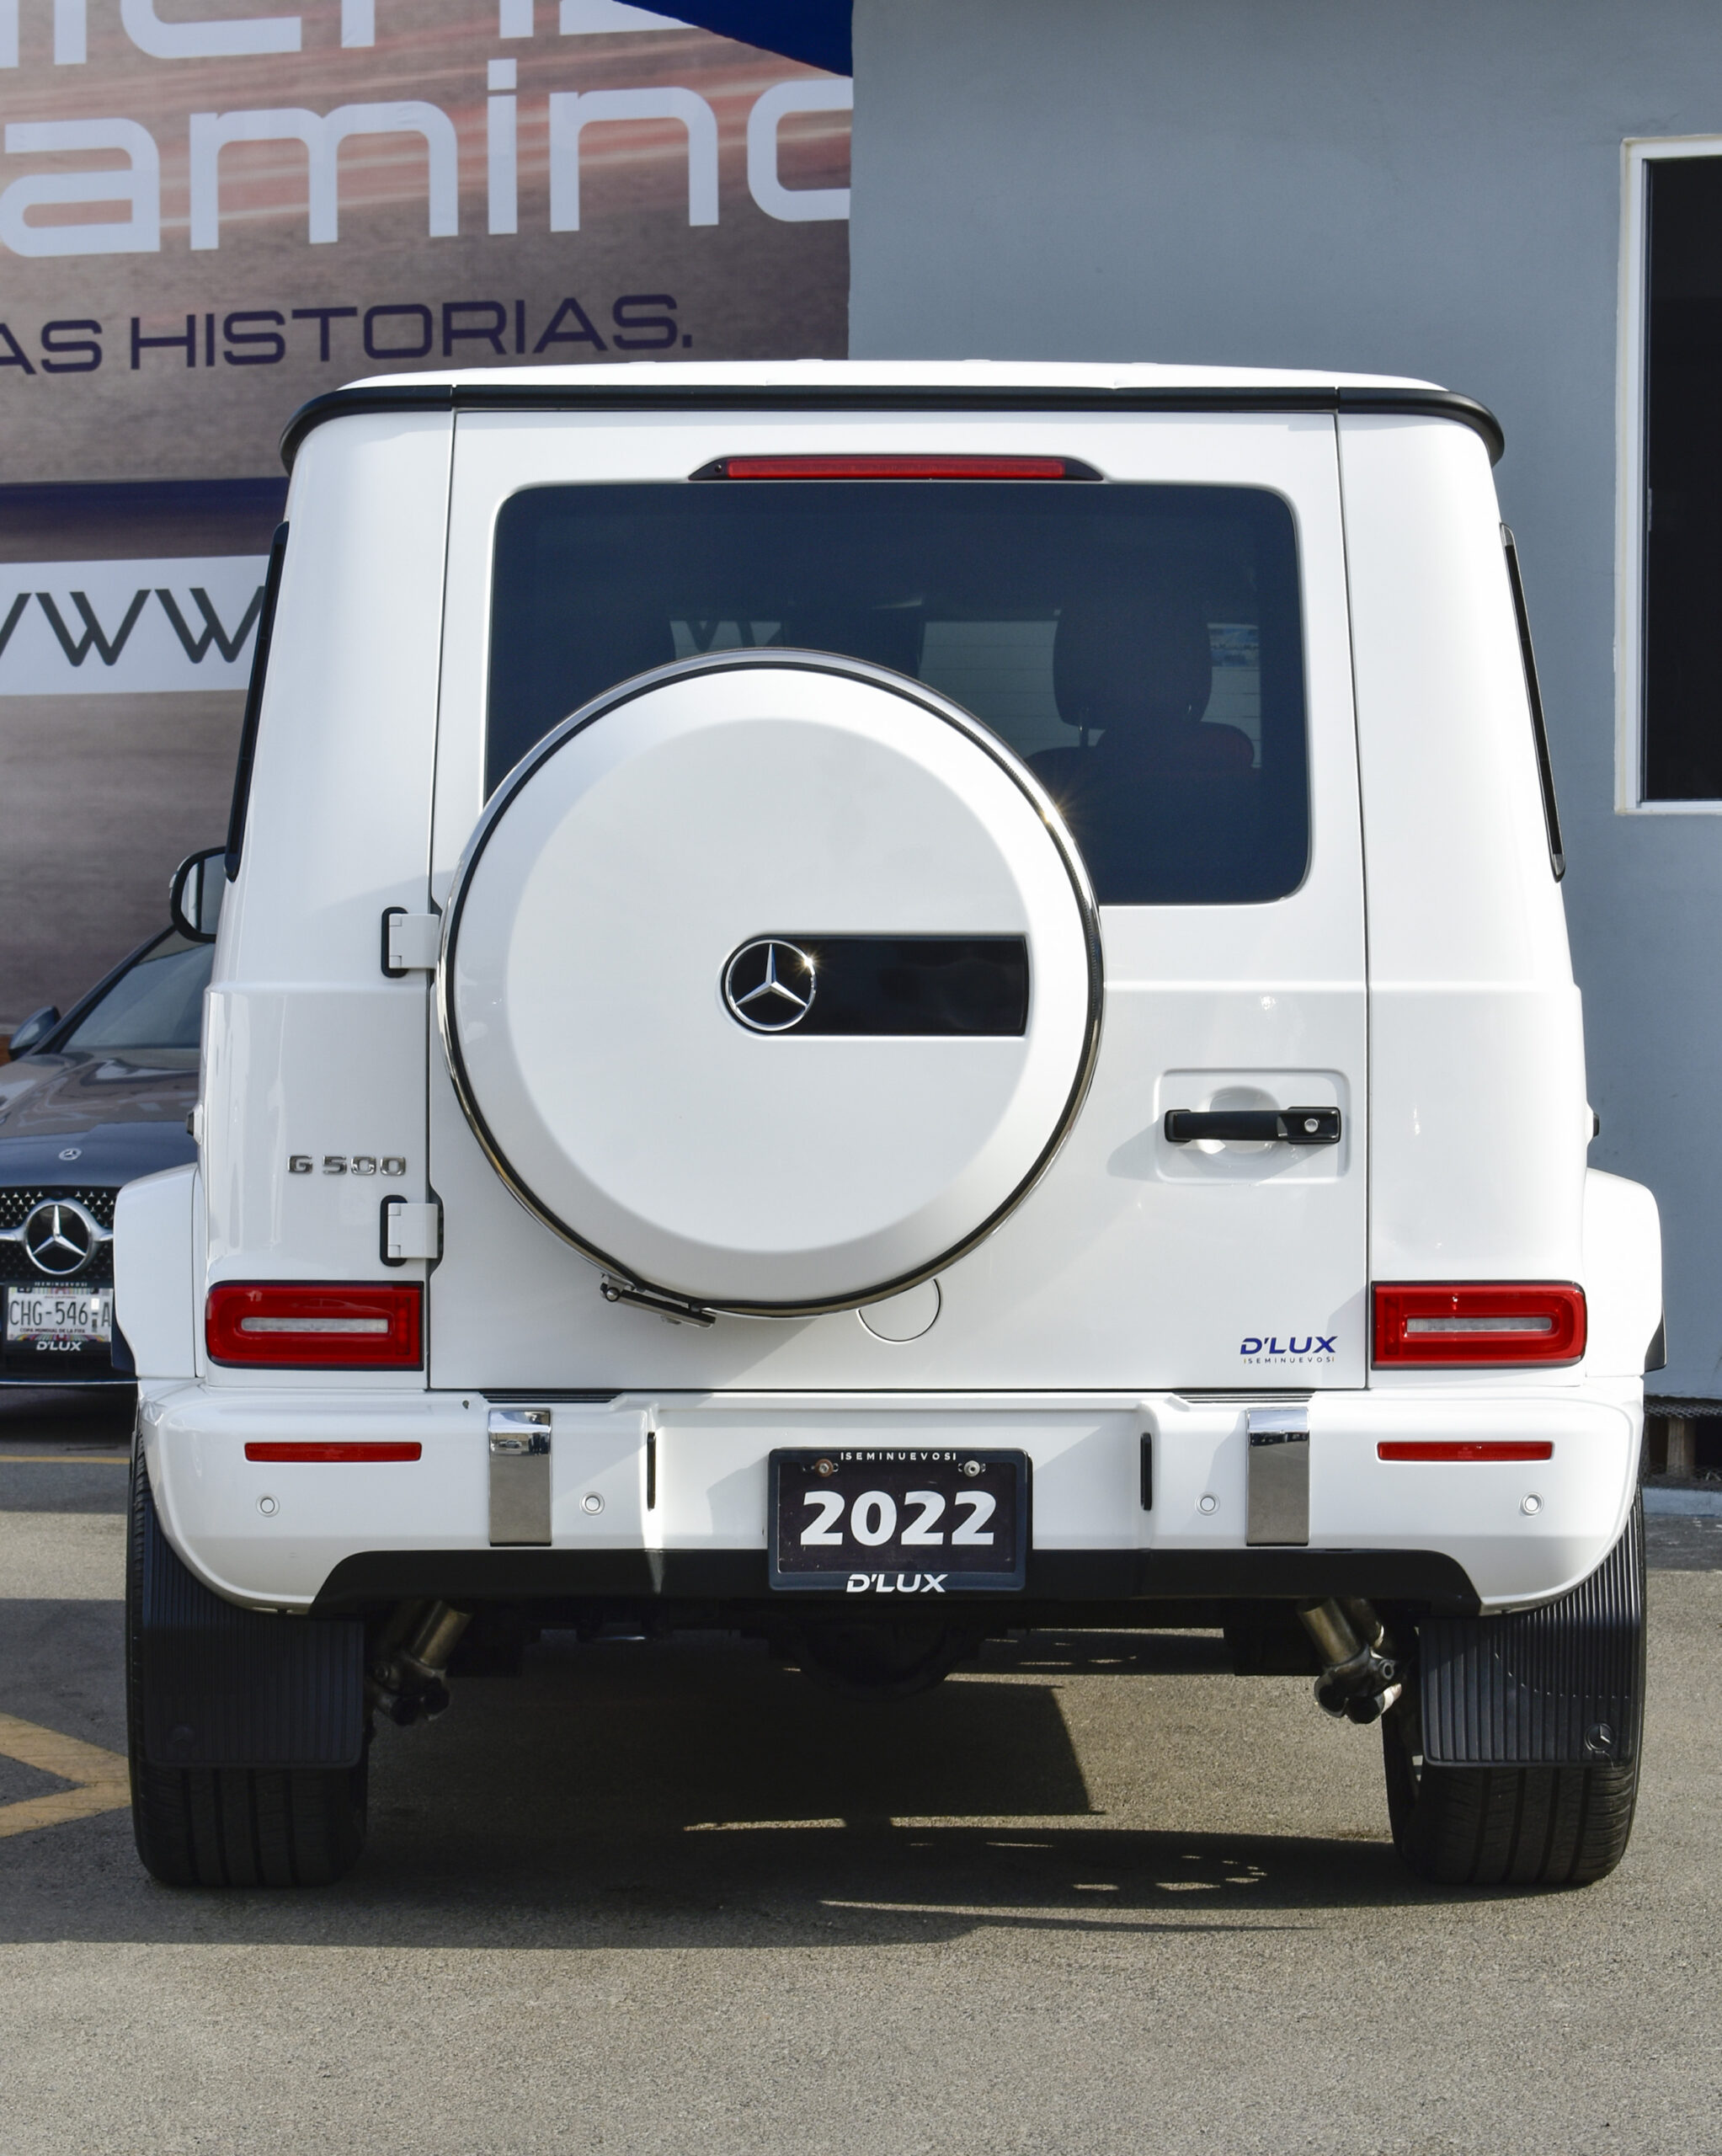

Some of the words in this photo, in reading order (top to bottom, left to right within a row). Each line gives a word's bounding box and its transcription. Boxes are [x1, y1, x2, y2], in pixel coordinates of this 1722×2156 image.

[131, 295, 692, 371] HISTORIAS.
[287, 1155, 312, 1174] G
[323, 1155, 407, 1176] 500
[10, 1300, 111, 1327] CHG-546-A
[36, 1341, 82, 1351] D'LUX
[1240, 1336, 1338, 1354] D'LUX
[801, 1491, 996, 1546] 2022
[846, 1574, 948, 1593] D'LUX
